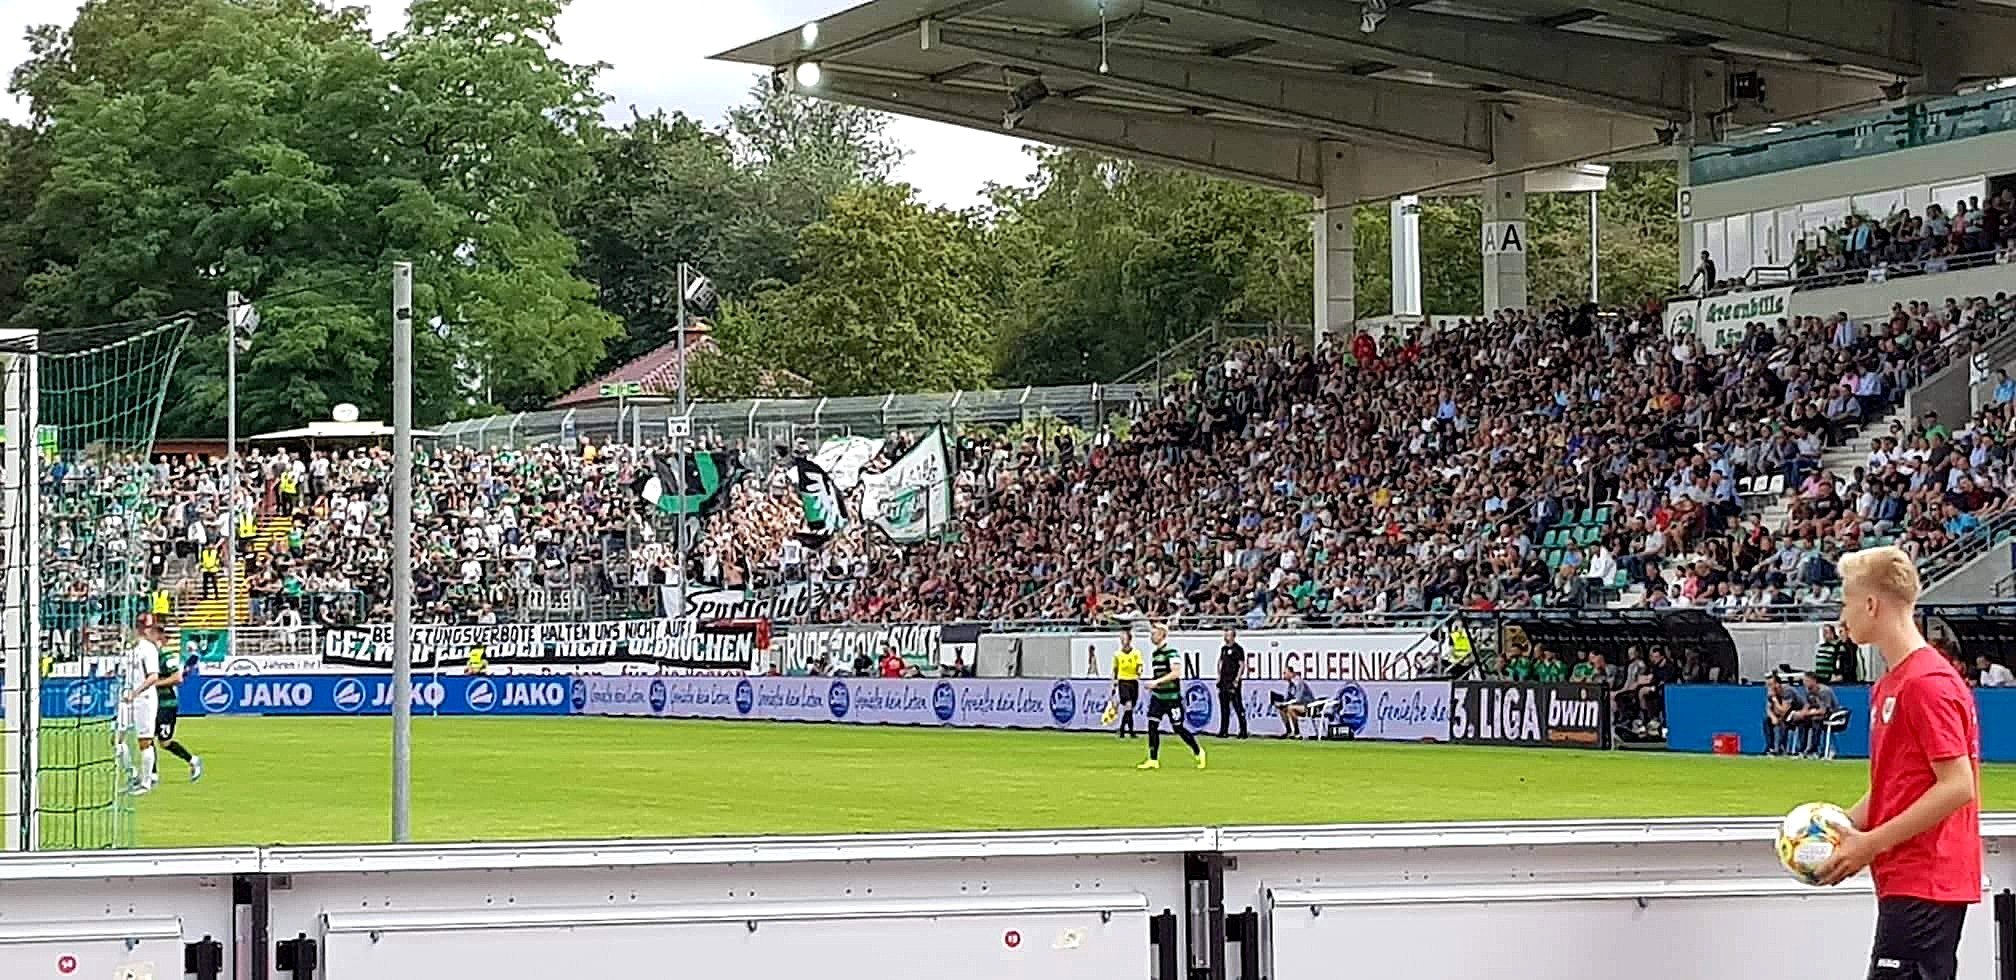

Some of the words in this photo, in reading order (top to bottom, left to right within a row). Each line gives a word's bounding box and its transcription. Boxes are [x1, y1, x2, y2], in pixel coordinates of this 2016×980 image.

[1681, 190, 1692, 218] B
[1485, 226, 1496, 252] A
[1501, 224, 1522, 251] A
[540, 622, 591, 641] HALTEN
[594, 622, 621, 641] UNS
[625, 621, 660, 639] NICHT
[240, 682, 313, 707] JAKO
[502, 682, 565, 706] JAKO
[1452, 687, 1475, 739] 3.
[1480, 687, 1541, 741] LIGA
[1548, 689, 1599, 728] bwin
